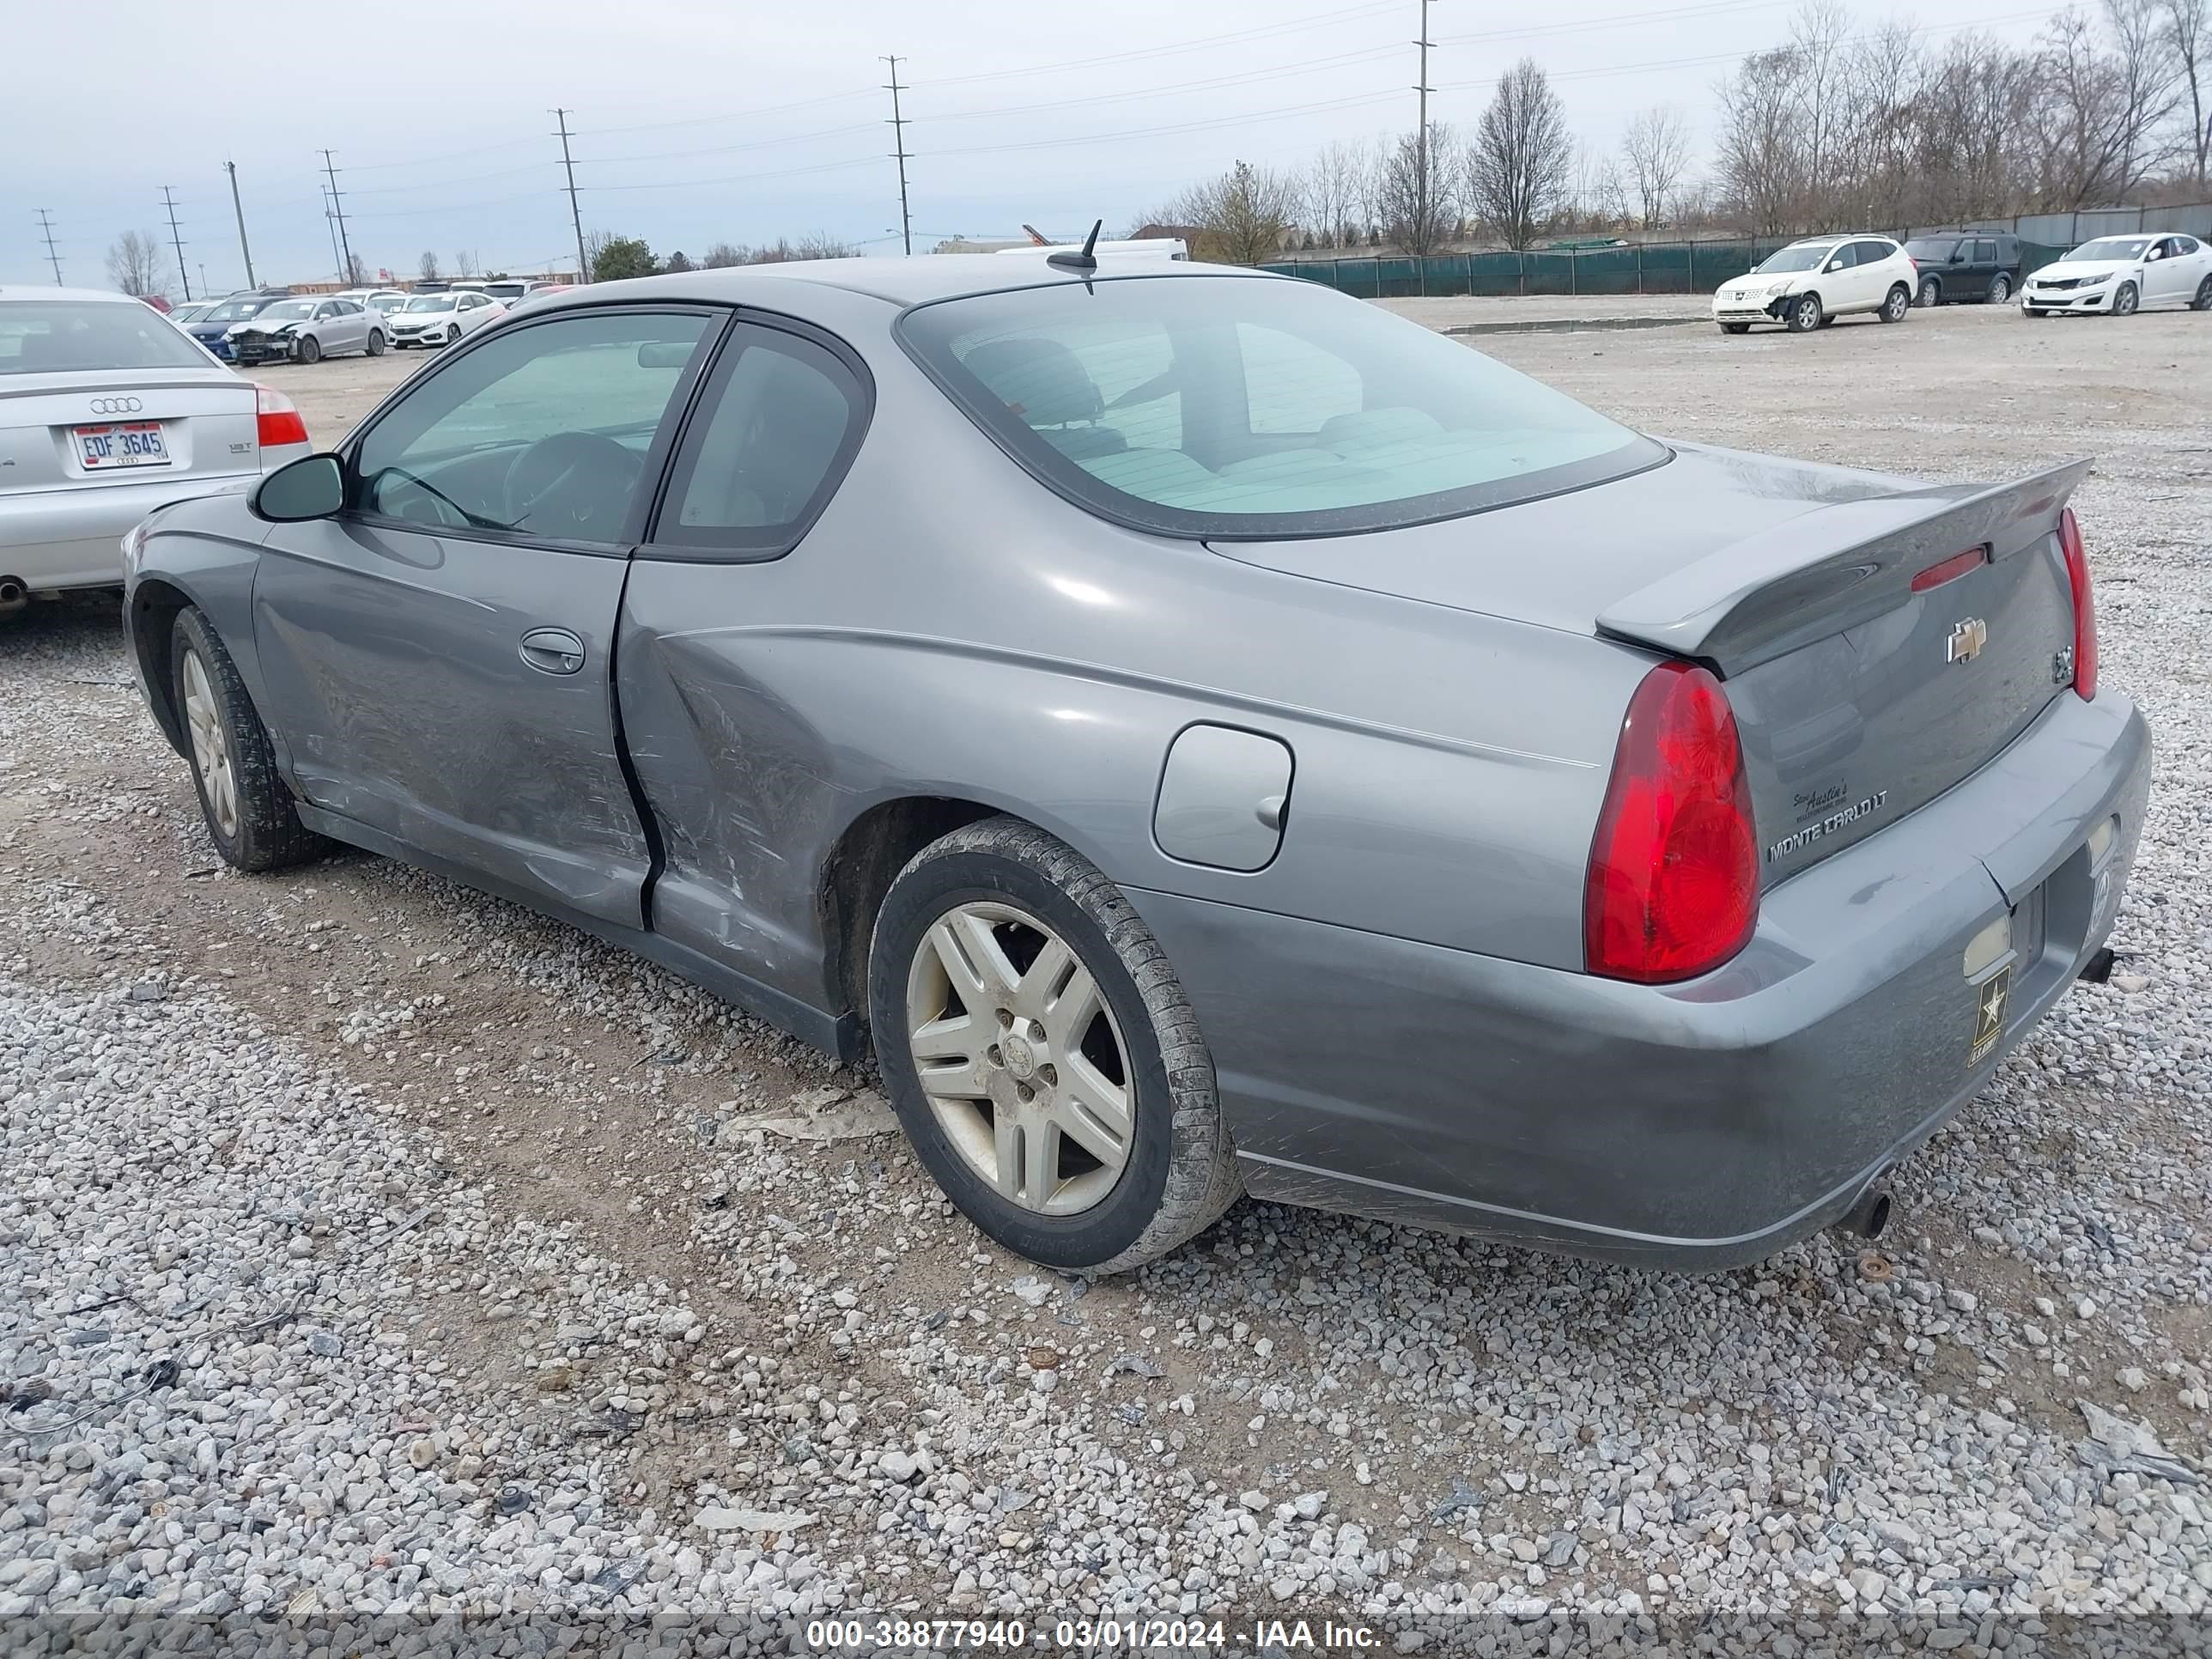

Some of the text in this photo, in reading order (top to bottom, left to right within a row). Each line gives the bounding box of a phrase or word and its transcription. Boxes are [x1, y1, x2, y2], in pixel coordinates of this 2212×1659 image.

[119, 432, 161, 454] 3645
[1805, 777, 1847, 813] Austin's
[1767, 823, 1820, 863] MONTE
[1821, 799, 1871, 835] CARLO
[1871, 790, 1887, 811] LT
